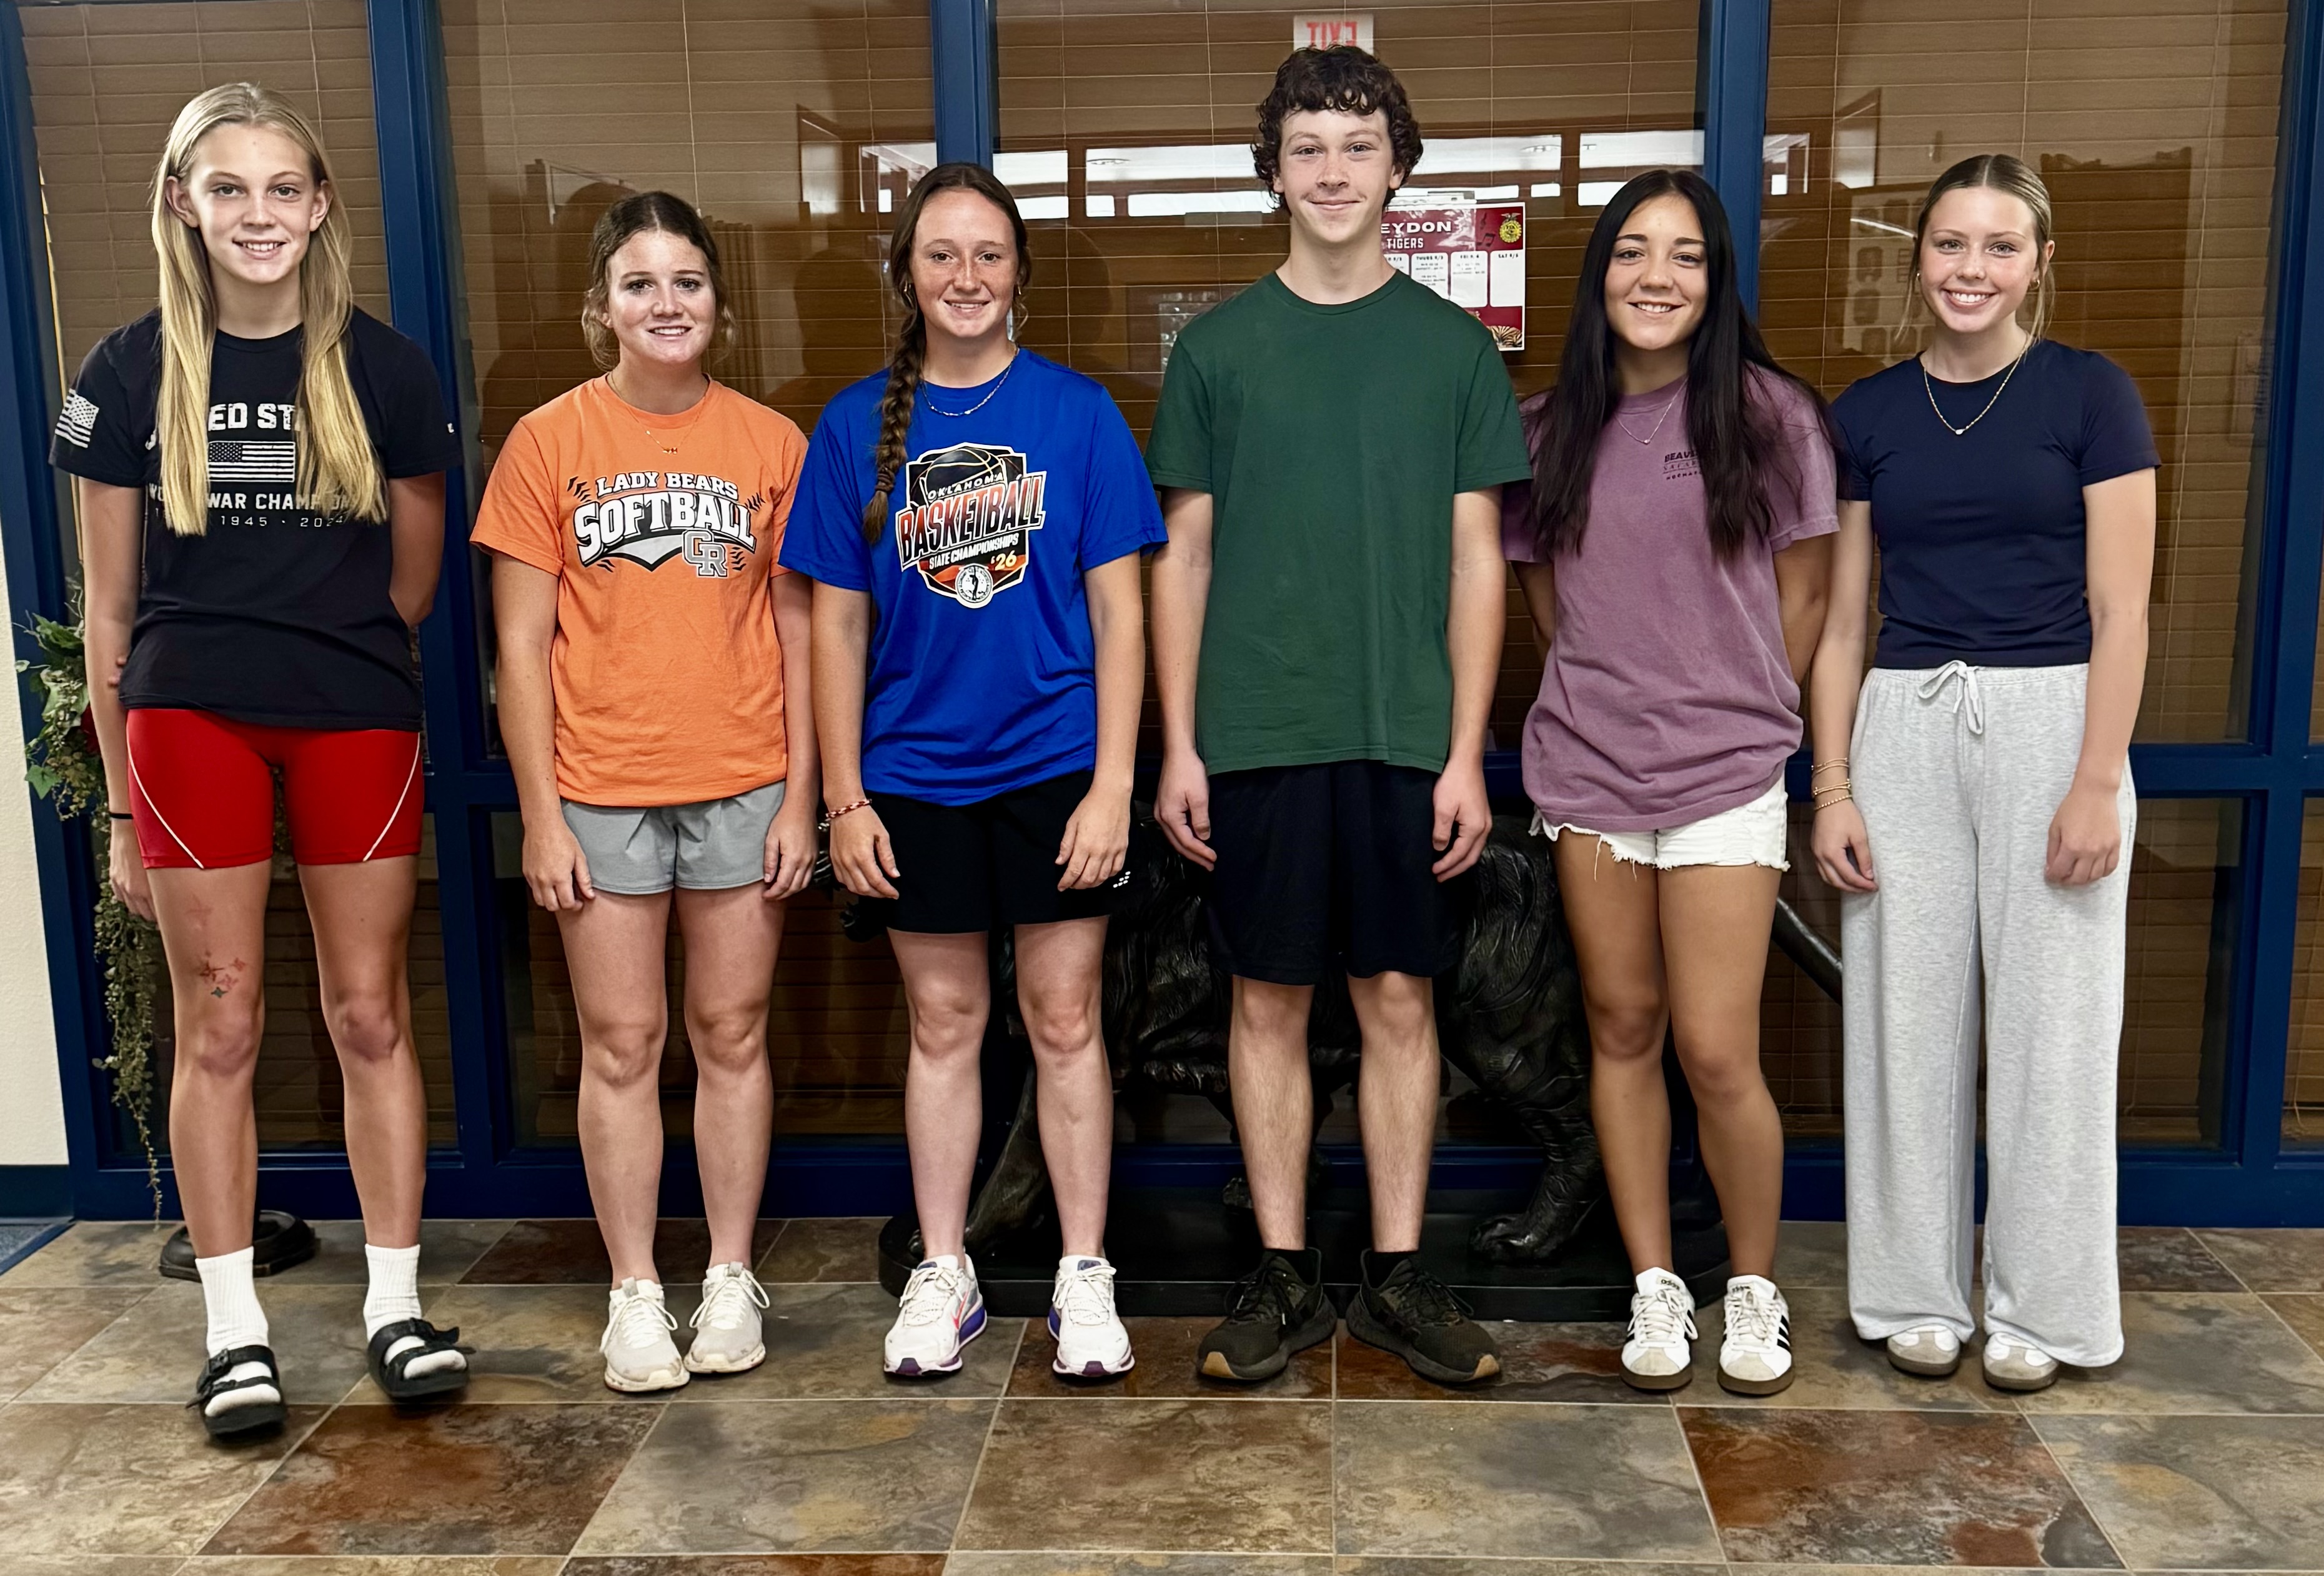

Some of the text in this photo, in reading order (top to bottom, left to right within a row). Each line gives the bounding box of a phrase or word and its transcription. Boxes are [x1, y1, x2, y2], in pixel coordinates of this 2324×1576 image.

[1386, 237, 1424, 249] TIGERS
[596, 472, 738, 497] LADY BEARS
[927, 472, 1005, 500] OKLAHOMA
[208, 492, 247, 509] WAR
[221, 516, 267, 526] 1945
[574, 491, 757, 566] SOFTBALL
[897, 474, 1045, 566] BASKETBALL
[929, 533, 1019, 569] STATE CHAMPIONSHIPS
